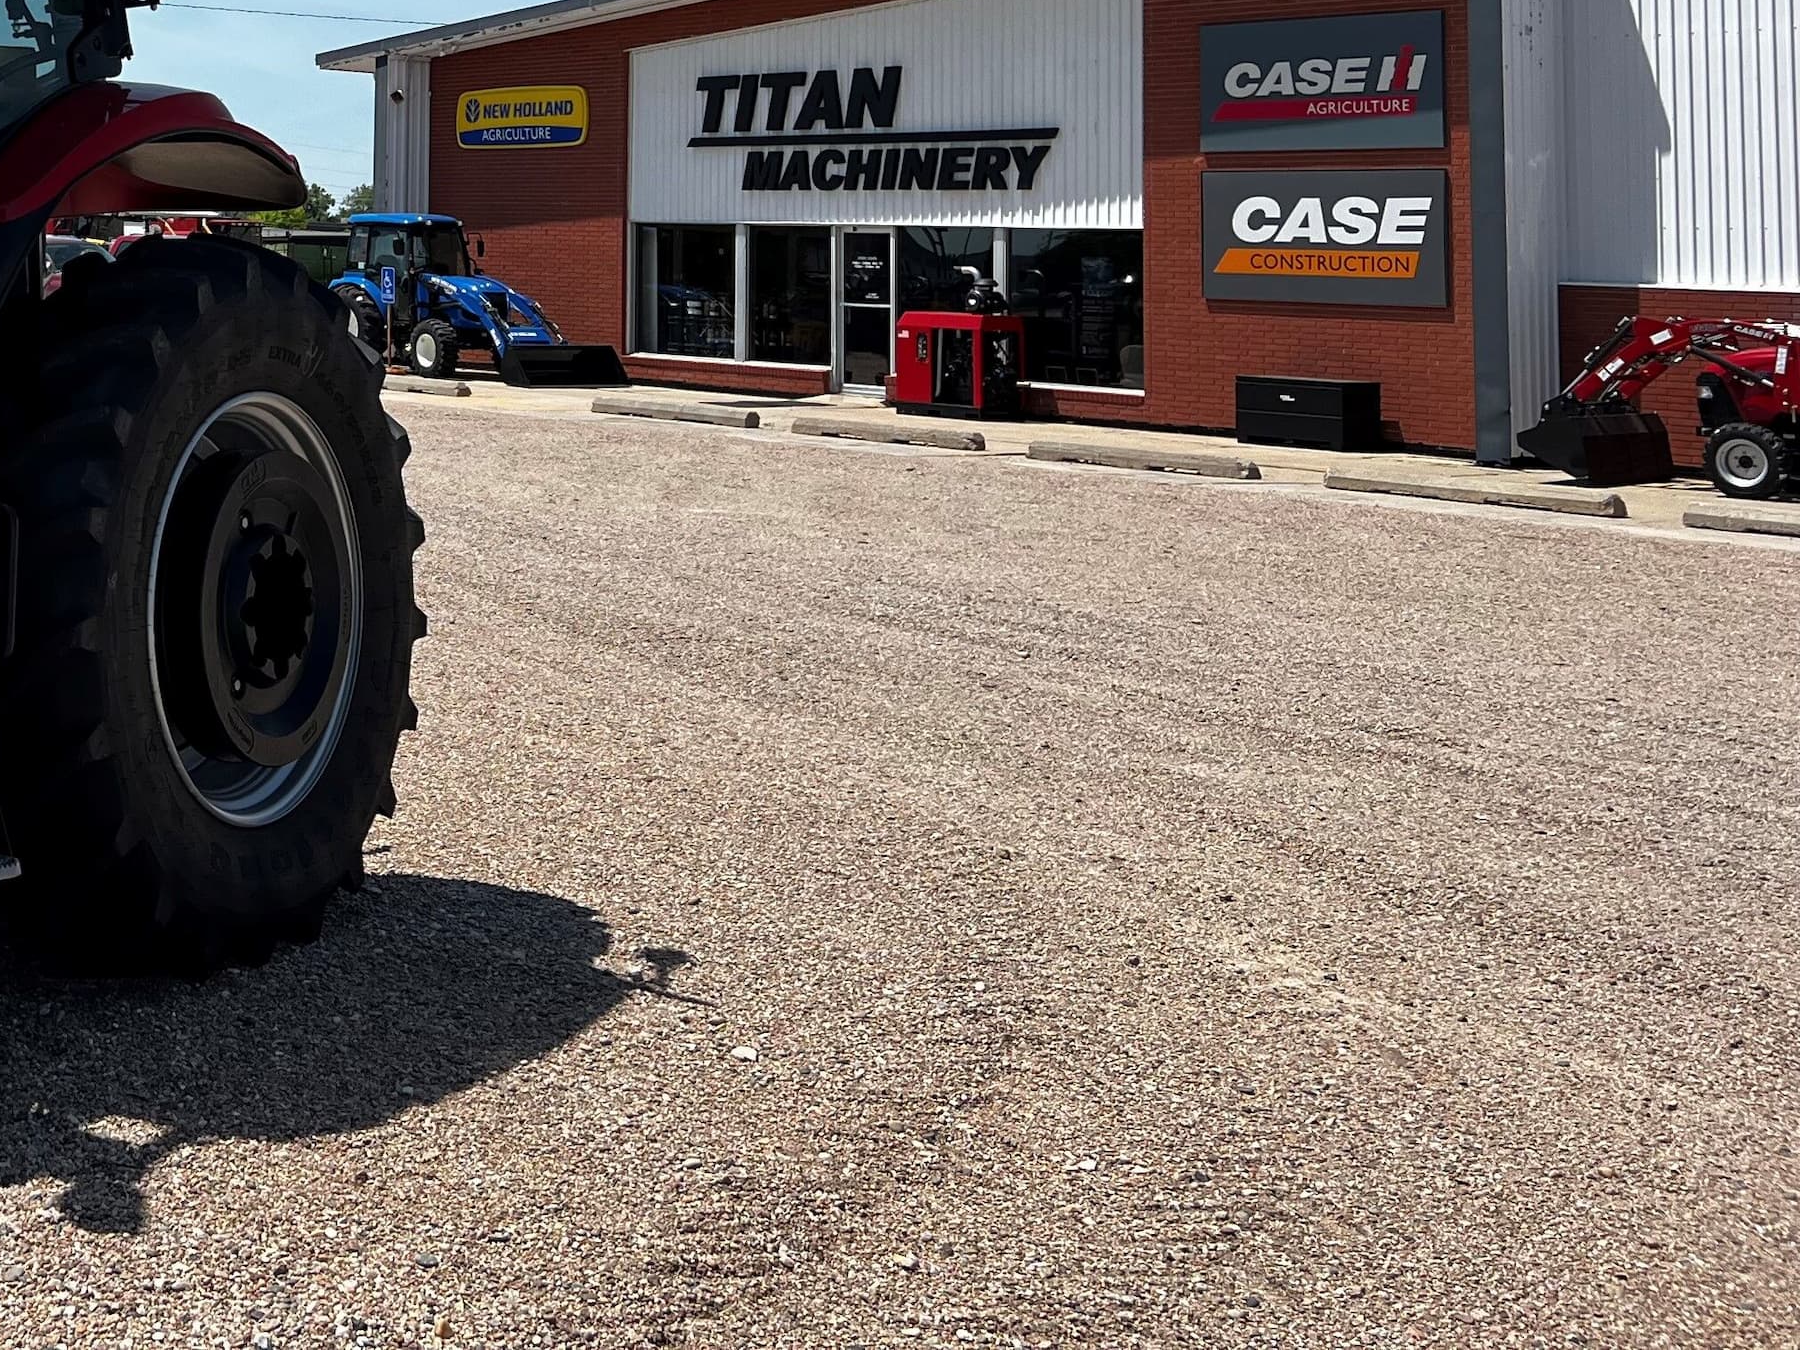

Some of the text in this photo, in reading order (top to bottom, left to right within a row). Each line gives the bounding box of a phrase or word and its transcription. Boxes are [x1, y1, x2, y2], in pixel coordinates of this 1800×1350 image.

[1224, 56, 1371, 98] CASE
[483, 100, 574, 119] NEW HOLLAND
[696, 65, 903, 134] TITAN
[1306, 99, 1411, 116] AGRICULTURE
[481, 127, 552, 142] AGRICULTURE
[741, 145, 1052, 191] MACHINERY
[1232, 196, 1432, 244] CASE
[1250, 253, 1409, 273] CONSTRUCTION
[1733, 325, 1763, 338] CASE
